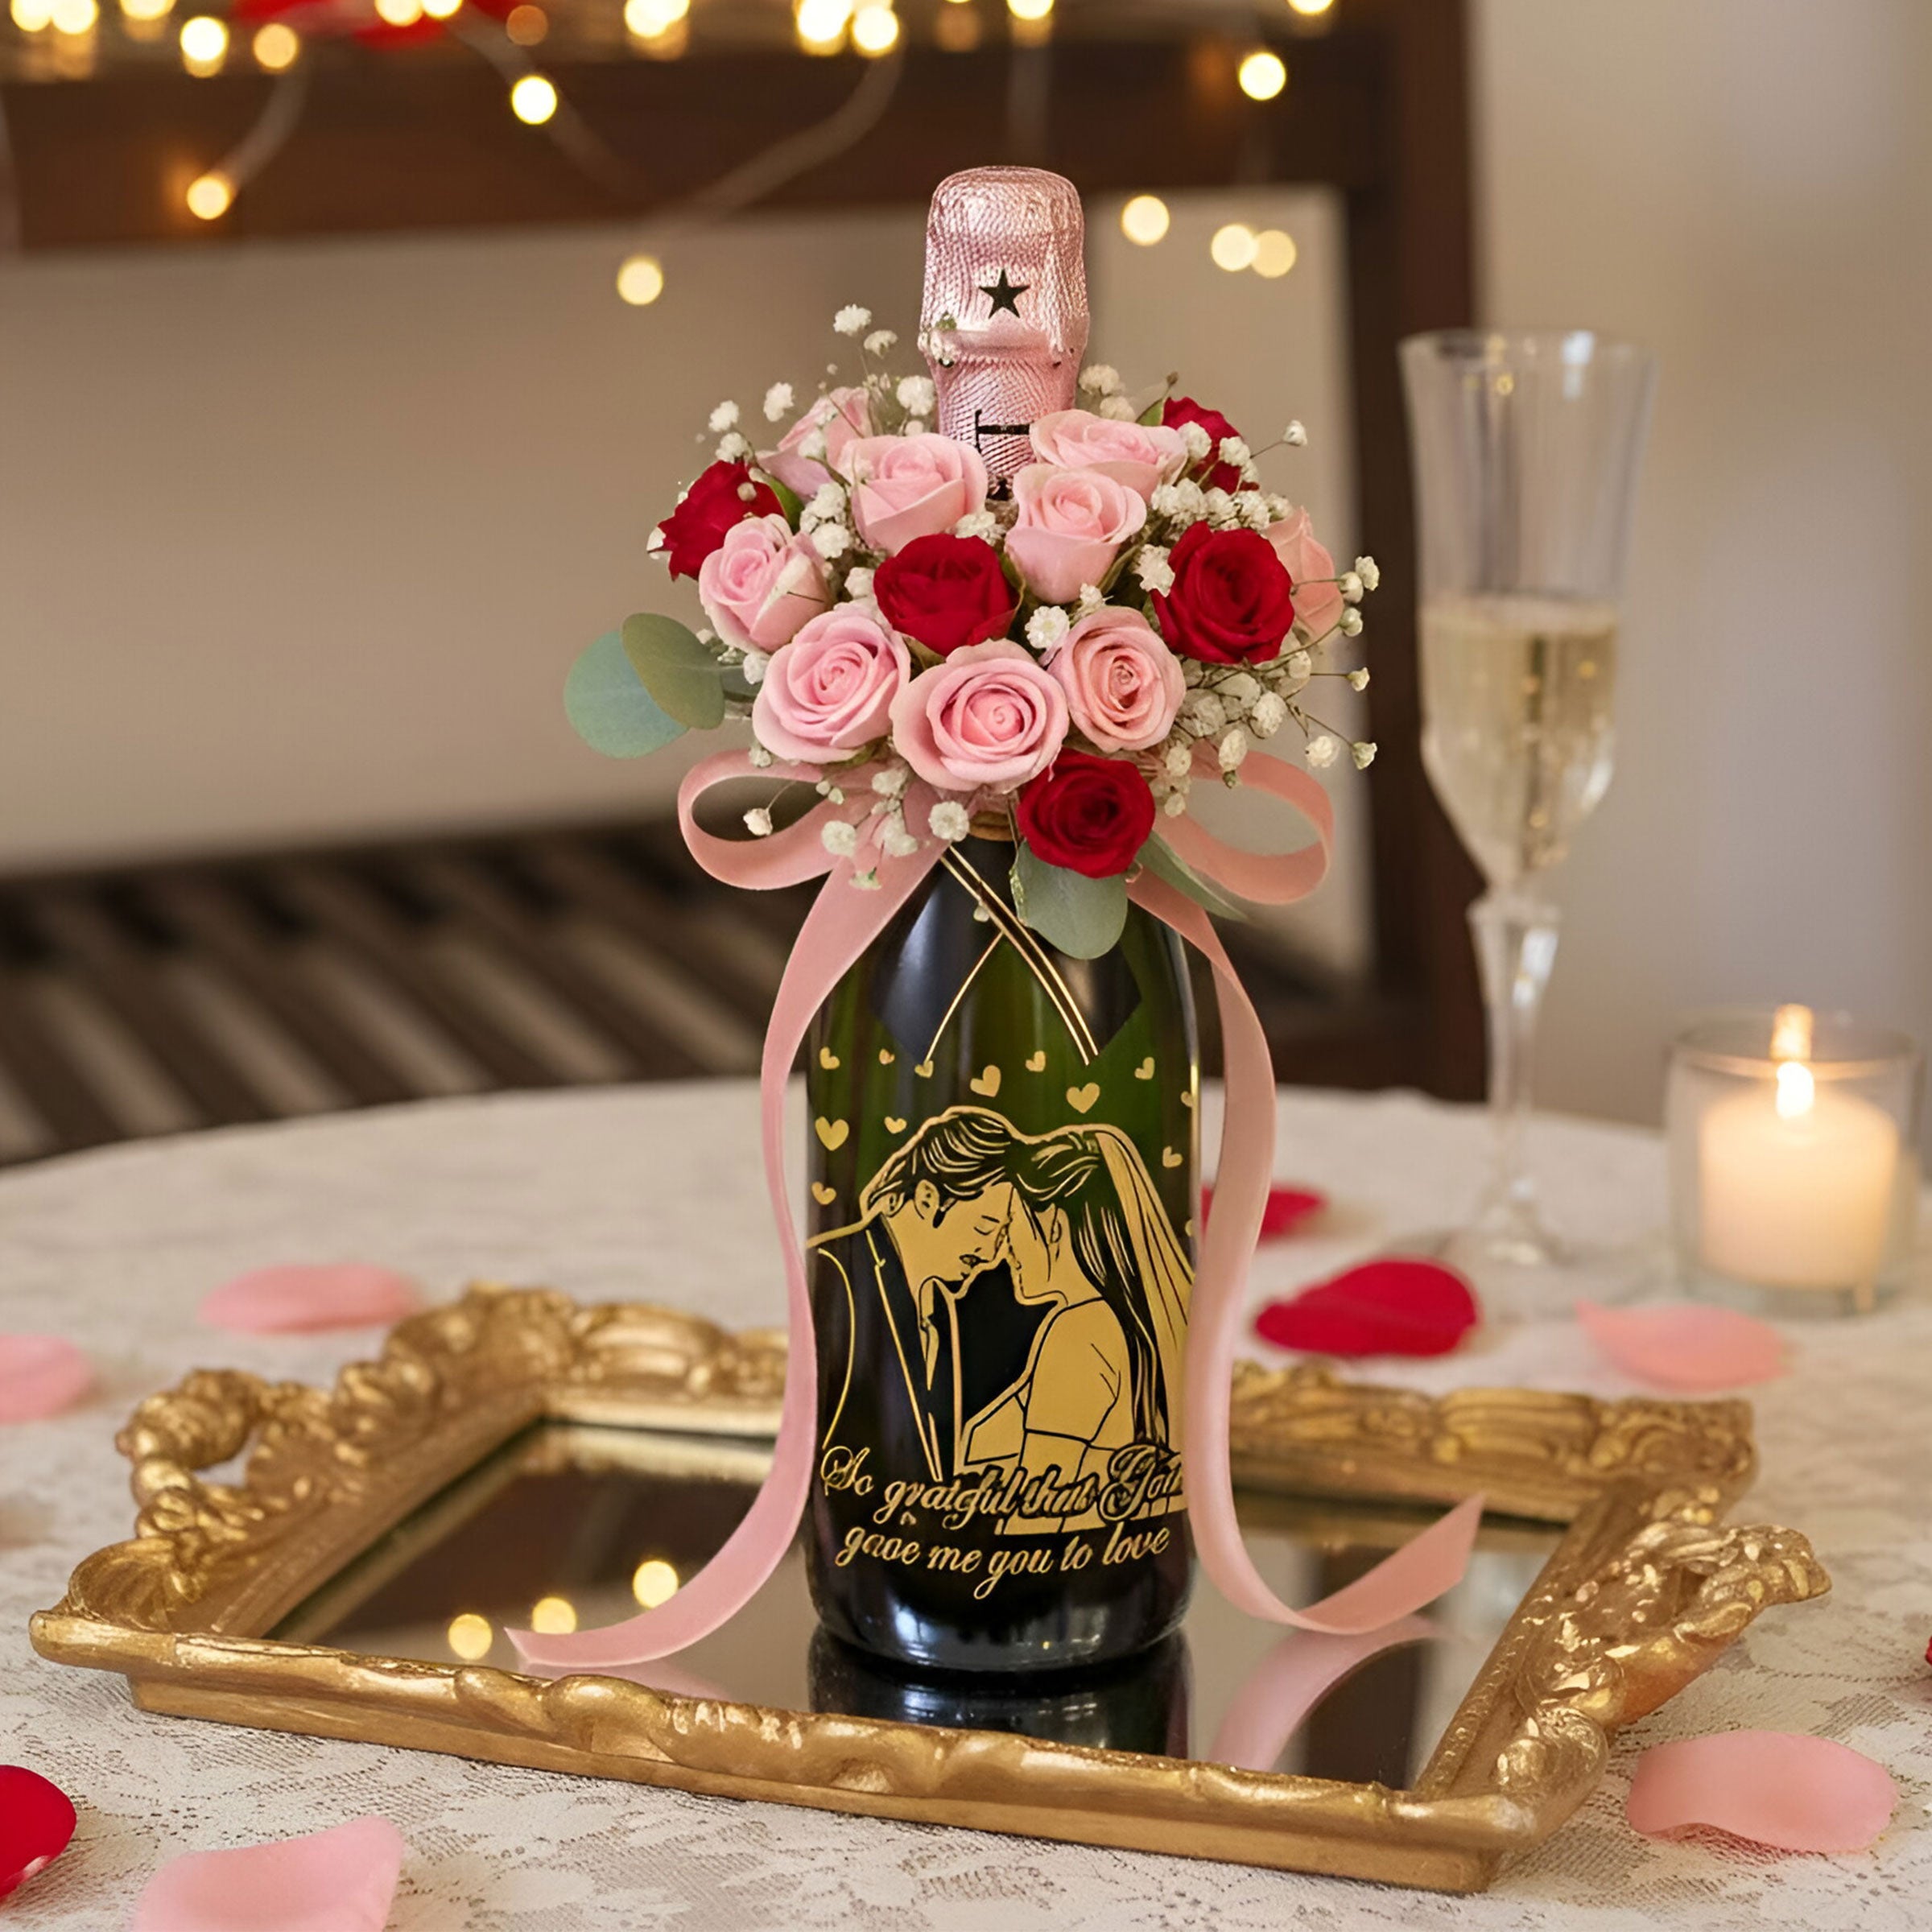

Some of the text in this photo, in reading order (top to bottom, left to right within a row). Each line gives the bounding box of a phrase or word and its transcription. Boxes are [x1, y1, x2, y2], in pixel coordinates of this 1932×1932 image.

[820, 1445, 875, 1496] So
[927, 1546, 983, 1573] me
[973, 1549, 1054, 1600] you
[1059, 1535, 1093, 1571] to
[1101, 1520, 1170, 1566] love
